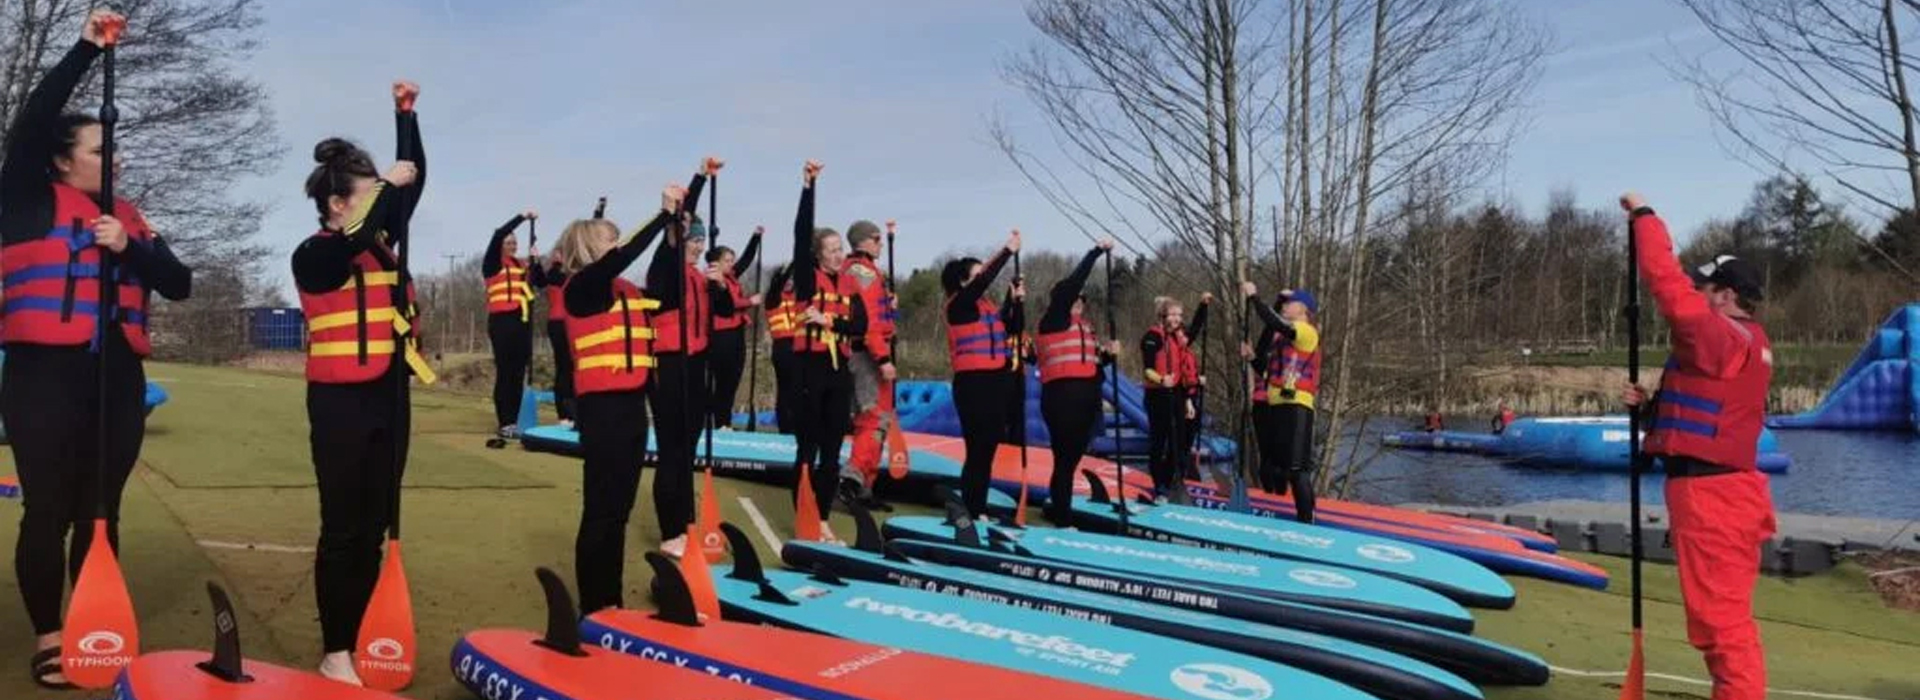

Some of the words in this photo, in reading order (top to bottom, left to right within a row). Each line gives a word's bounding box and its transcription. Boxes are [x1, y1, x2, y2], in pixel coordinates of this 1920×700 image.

[1055, 571, 1071, 584] SUP
[1076, 575, 1119, 592] ALLROUND
[1152, 587, 1171, 601] FEET
[1173, 590, 1197, 605] BARE
[1199, 595, 1218, 609] TWO
[67, 656, 132, 669] TYPHOON
[360, 659, 412, 673] TYPHOON
